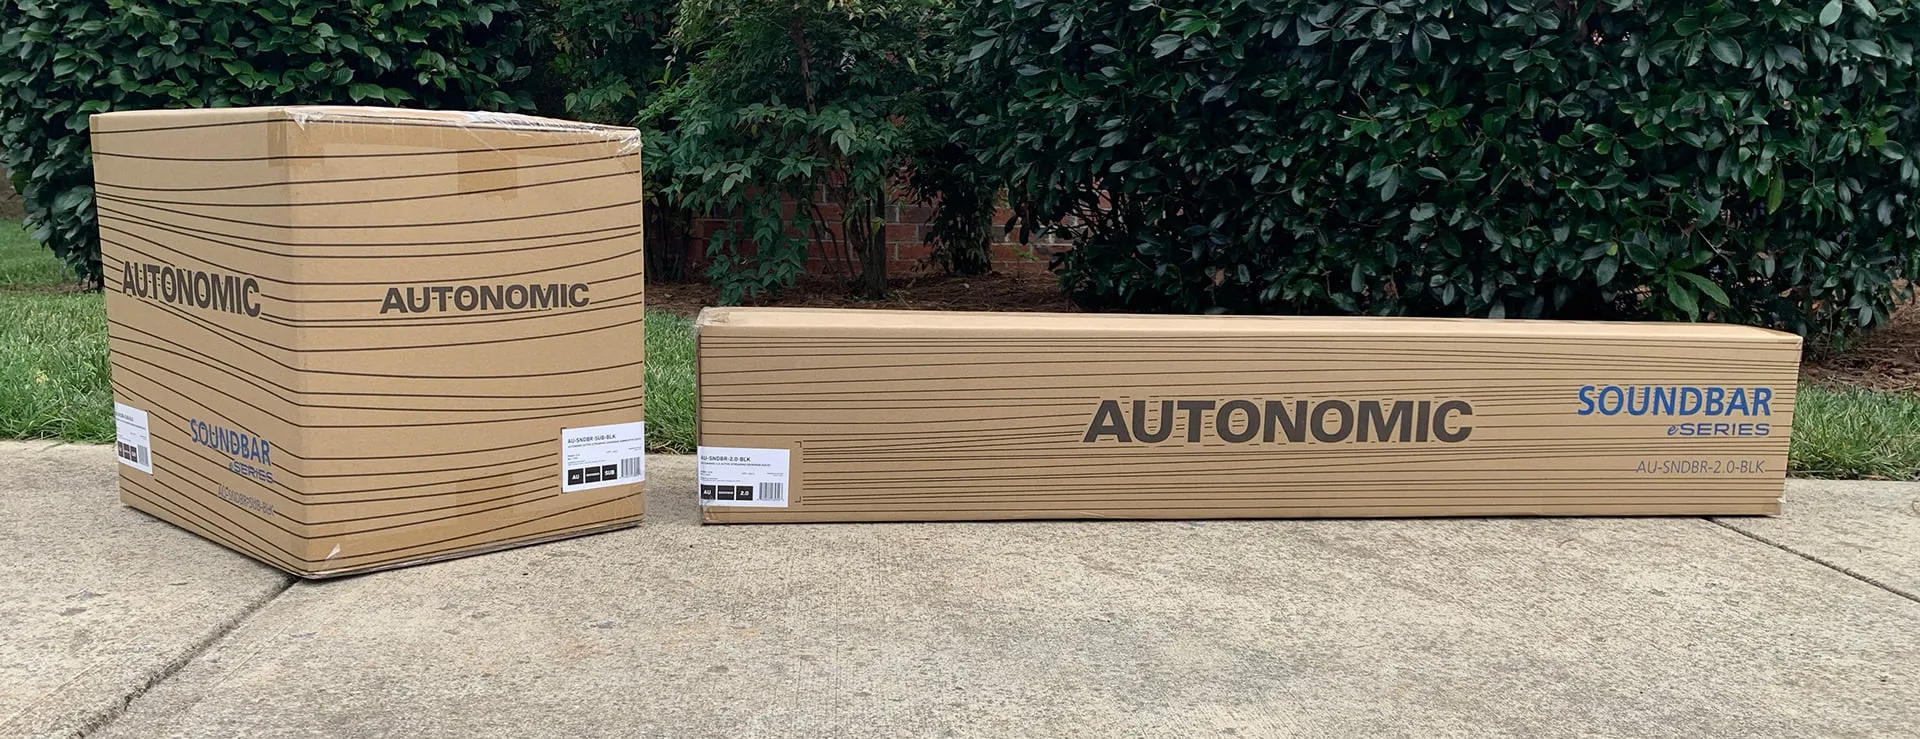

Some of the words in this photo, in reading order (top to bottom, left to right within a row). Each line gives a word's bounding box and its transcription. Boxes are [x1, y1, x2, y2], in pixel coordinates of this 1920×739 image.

[123, 261, 261, 318] AUTONOMIC
[379, 283, 590, 314] AUTONOMIC
[1577, 385, 1773, 416] SOUNDBAR
[1082, 399, 1473, 443] AUTONOMIC
[1667, 422, 1770, 436] eSERIES
[189, 418, 272, 467] SOUNDBAR
[1635, 460, 1766, 474] AU-SNDBR-2.0-BLK
